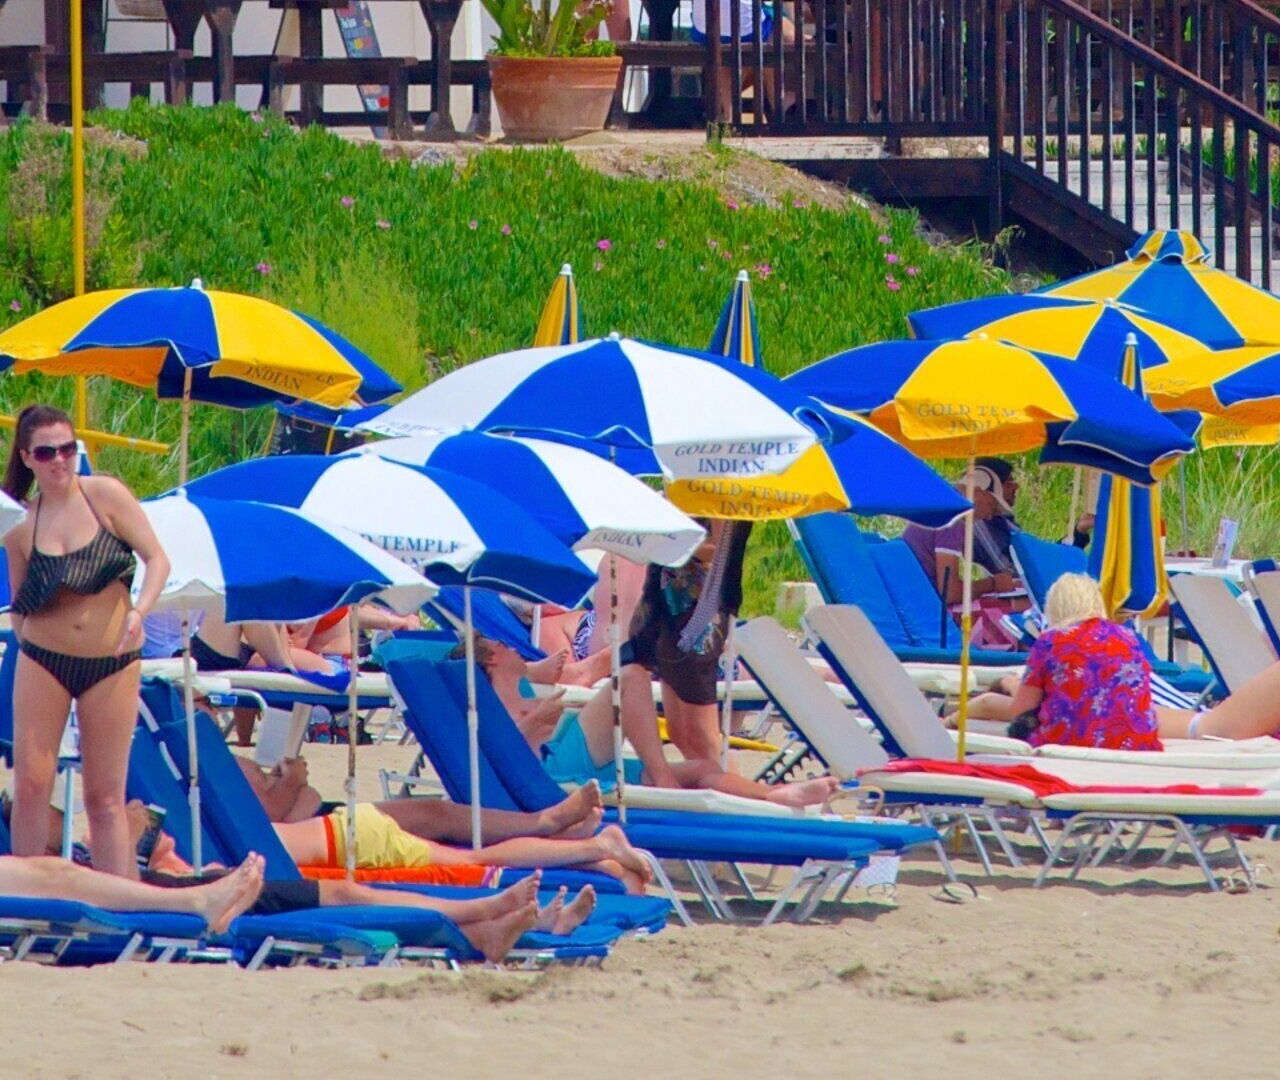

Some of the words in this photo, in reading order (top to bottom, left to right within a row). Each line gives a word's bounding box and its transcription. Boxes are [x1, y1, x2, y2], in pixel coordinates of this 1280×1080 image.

[244, 366, 302, 390] INDIAN
[917, 403, 970, 417] GOLD
[977, 405, 1016, 418] TEM
[675, 443, 722, 457] GOLD
[728, 442, 799, 457] TEMPLE
[699, 458, 765, 473] INDIAN
[687, 480, 743, 496] GOLD
[378, 535, 461, 554] TEMPLE
